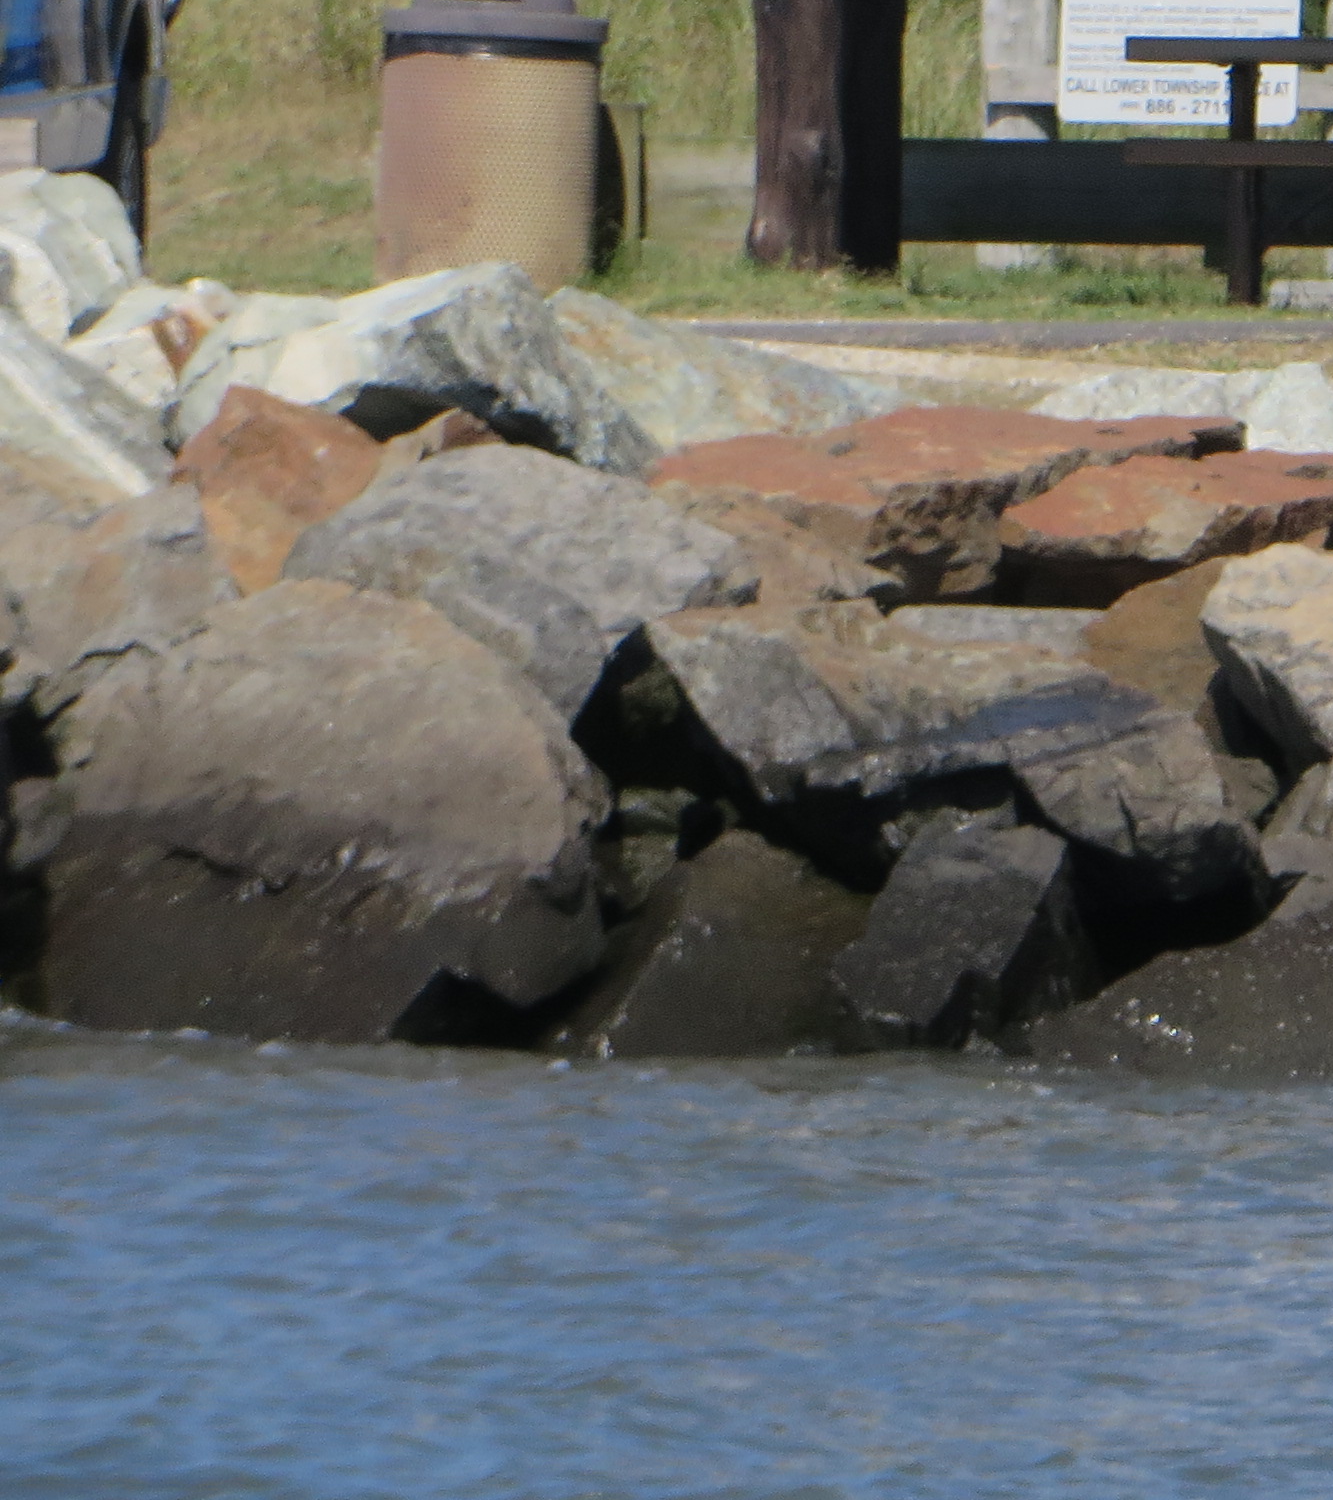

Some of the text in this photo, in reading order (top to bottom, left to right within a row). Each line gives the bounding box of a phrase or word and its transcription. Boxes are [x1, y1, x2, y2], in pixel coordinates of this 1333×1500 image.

[1067, 77, 1098, 93] CALL
[1103, 78, 1148, 94] LOWER
[1153, 78, 1220, 94] TOWNSHIP
[1274, 81, 1290, 95] AT
